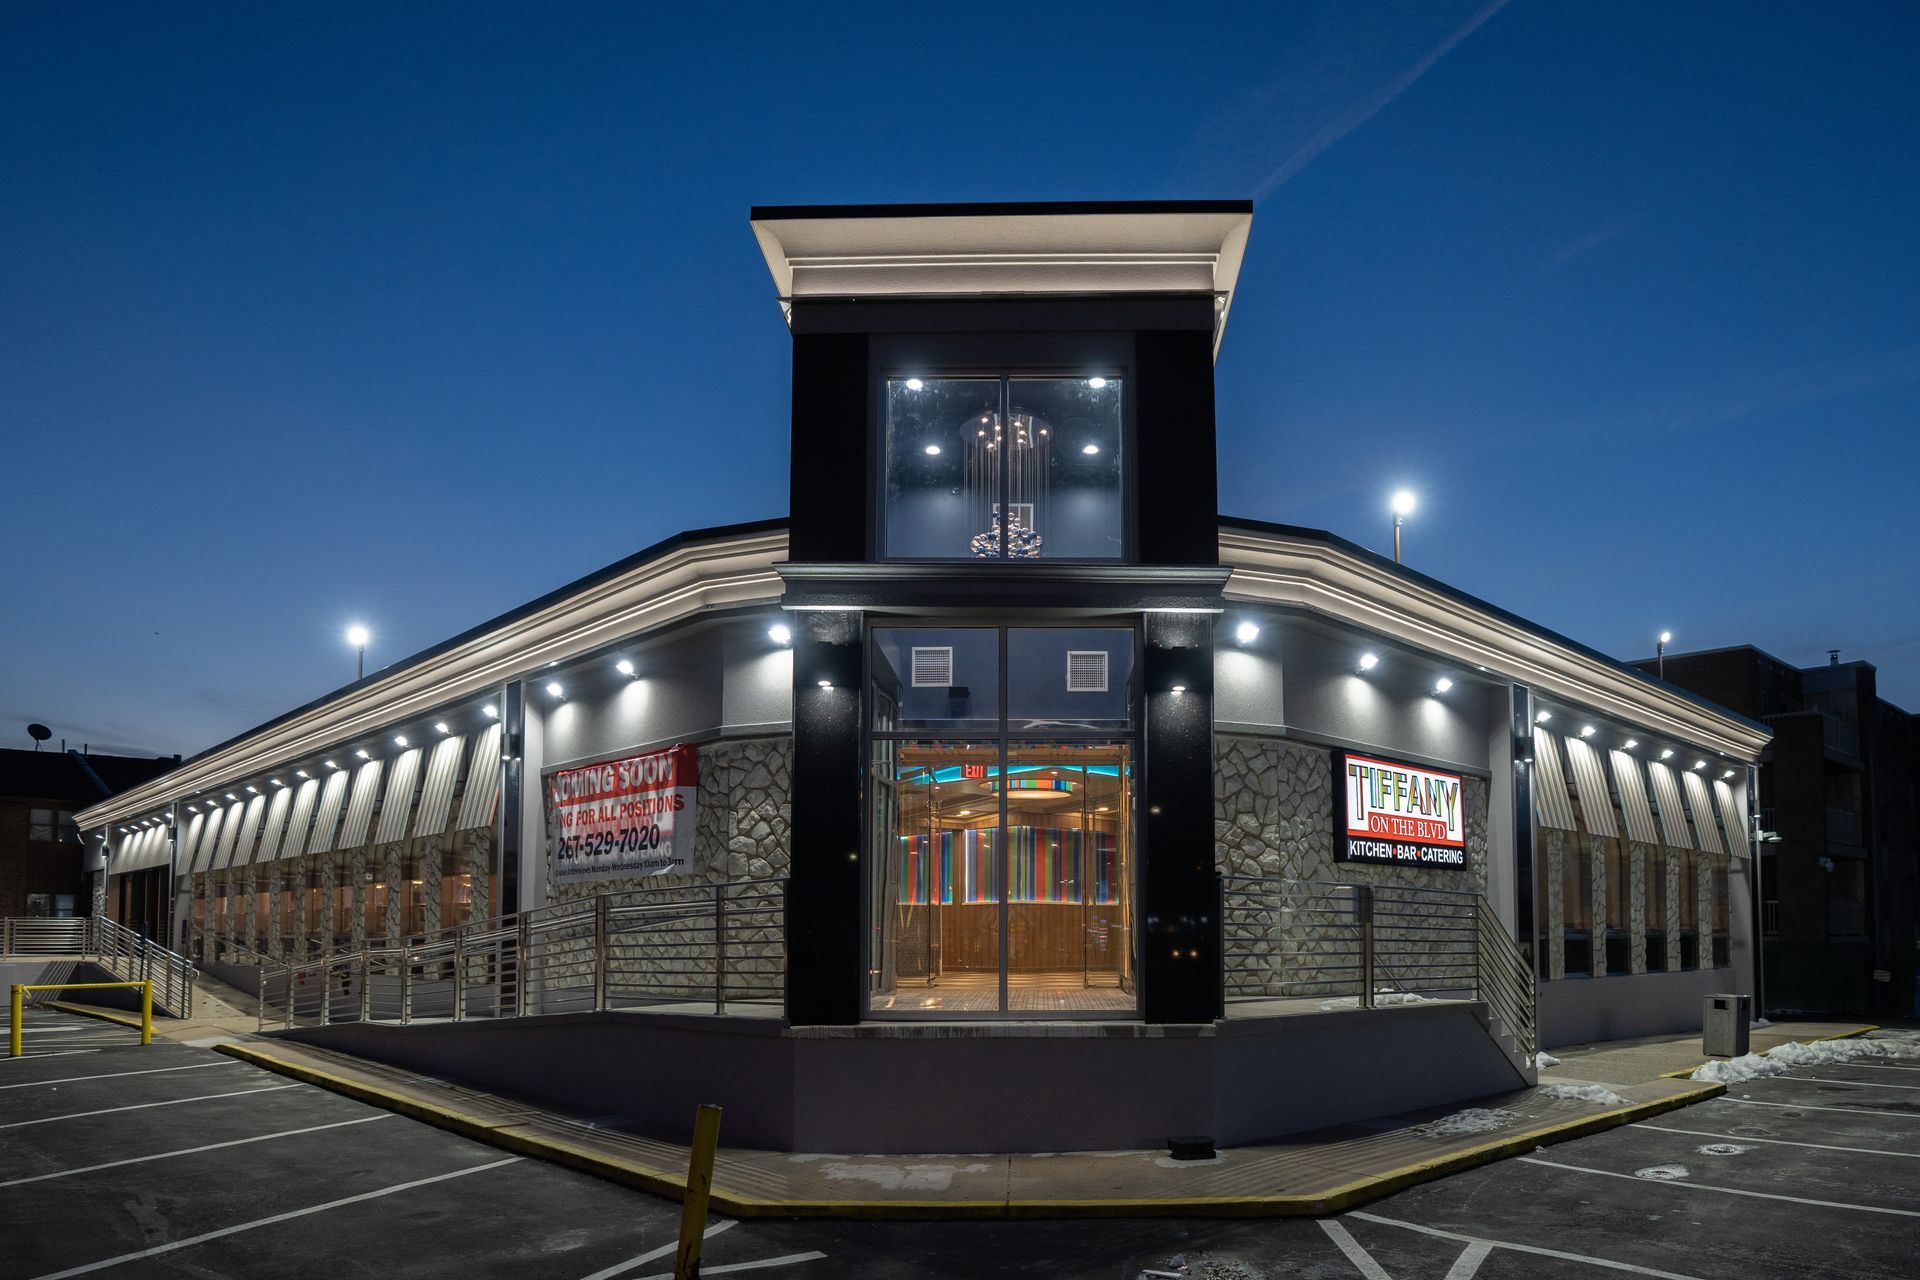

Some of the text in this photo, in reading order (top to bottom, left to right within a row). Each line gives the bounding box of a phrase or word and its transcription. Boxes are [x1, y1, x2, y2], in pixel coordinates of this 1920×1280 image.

[618, 754, 673, 789] SOON
[965, 765, 984, 778] EXIT
[576, 810, 595, 827] FOR
[598, 805, 617, 823] ALL
[620, 793, 685, 819] POSITIONS
[1348, 763, 1459, 831] TIFFANY
[557, 823, 660, 860] 267-529-7020
[1370, 815, 1446, 840] ON THE BLVD
[660, 859, 667, 867] to
[1350, 840, 1463, 864] KITCHEN BAR CATERING
